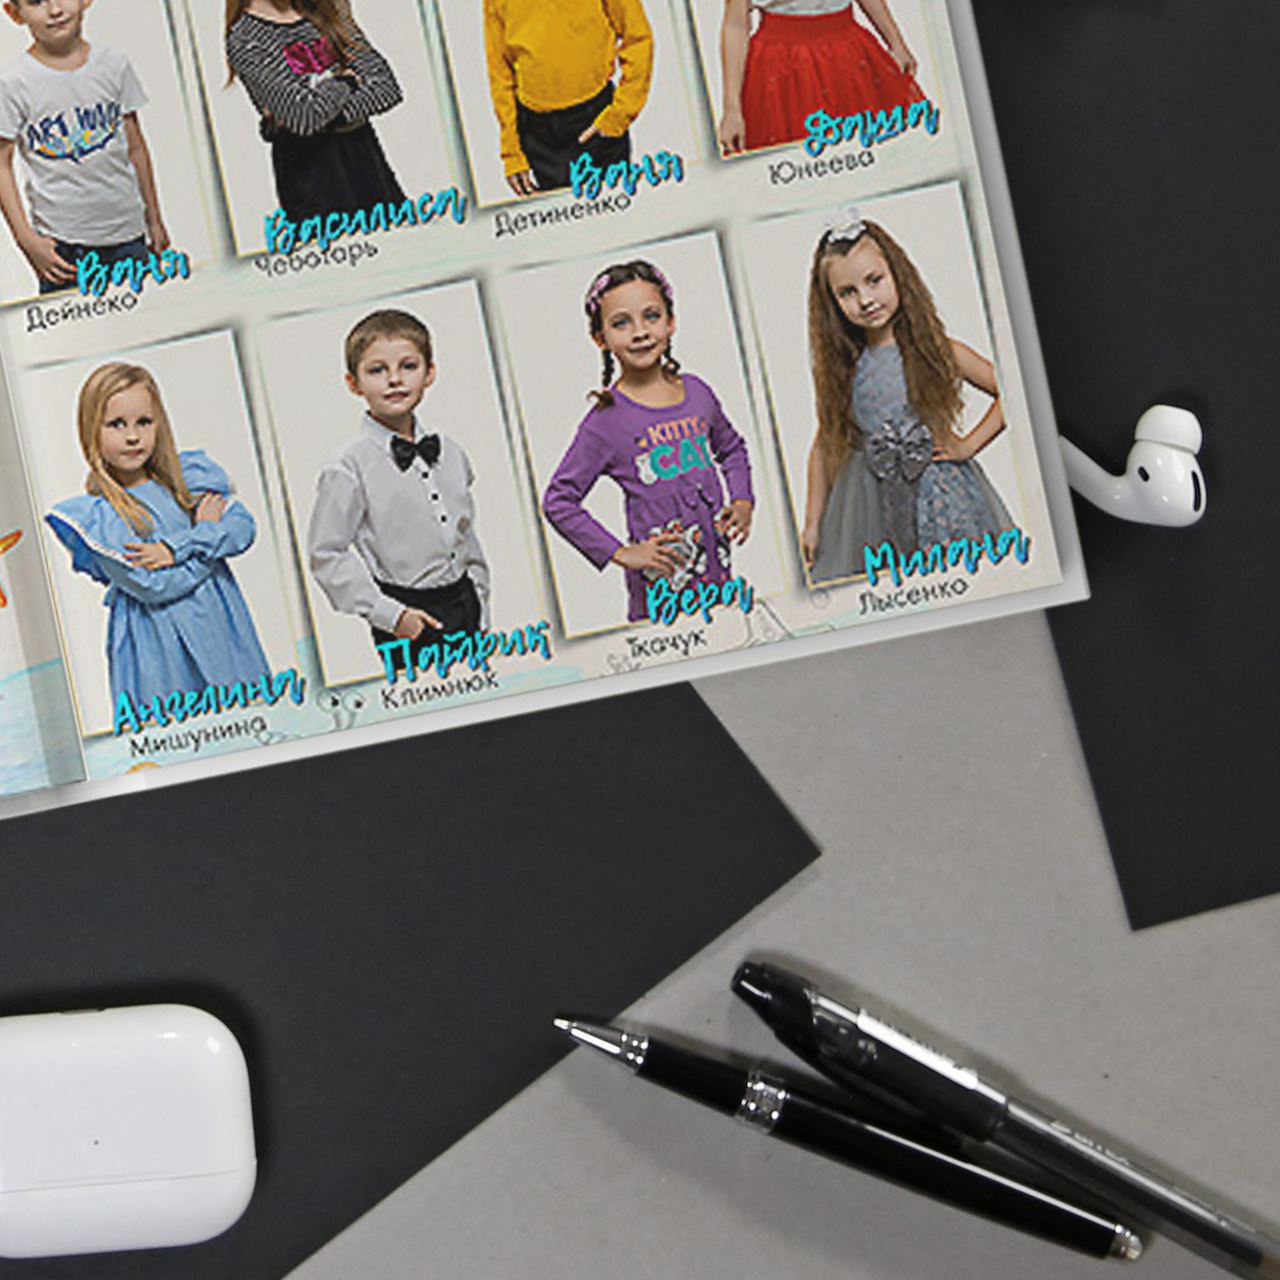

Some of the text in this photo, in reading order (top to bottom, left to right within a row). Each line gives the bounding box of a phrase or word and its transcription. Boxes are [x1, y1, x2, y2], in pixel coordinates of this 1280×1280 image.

[803, 98, 940, 158] Даша
[570, 150, 684, 201] Ваня
[768, 150, 876, 185] Юнеева
[263, 186, 468, 255] Василиса
[74, 247, 191, 297] Ваня
[26, 292, 138, 333] Дейнеко
[863, 525, 1031, 587] Милана
[645, 575, 754, 626] Вера
[858, 577, 970, 616] Лысенко
[375, 619, 552, 685] Патрик
[625, 629, 708, 659] Ткачук
[113, 667, 307, 737] Ангелина
[129, 715, 268, 758] Мишунина
